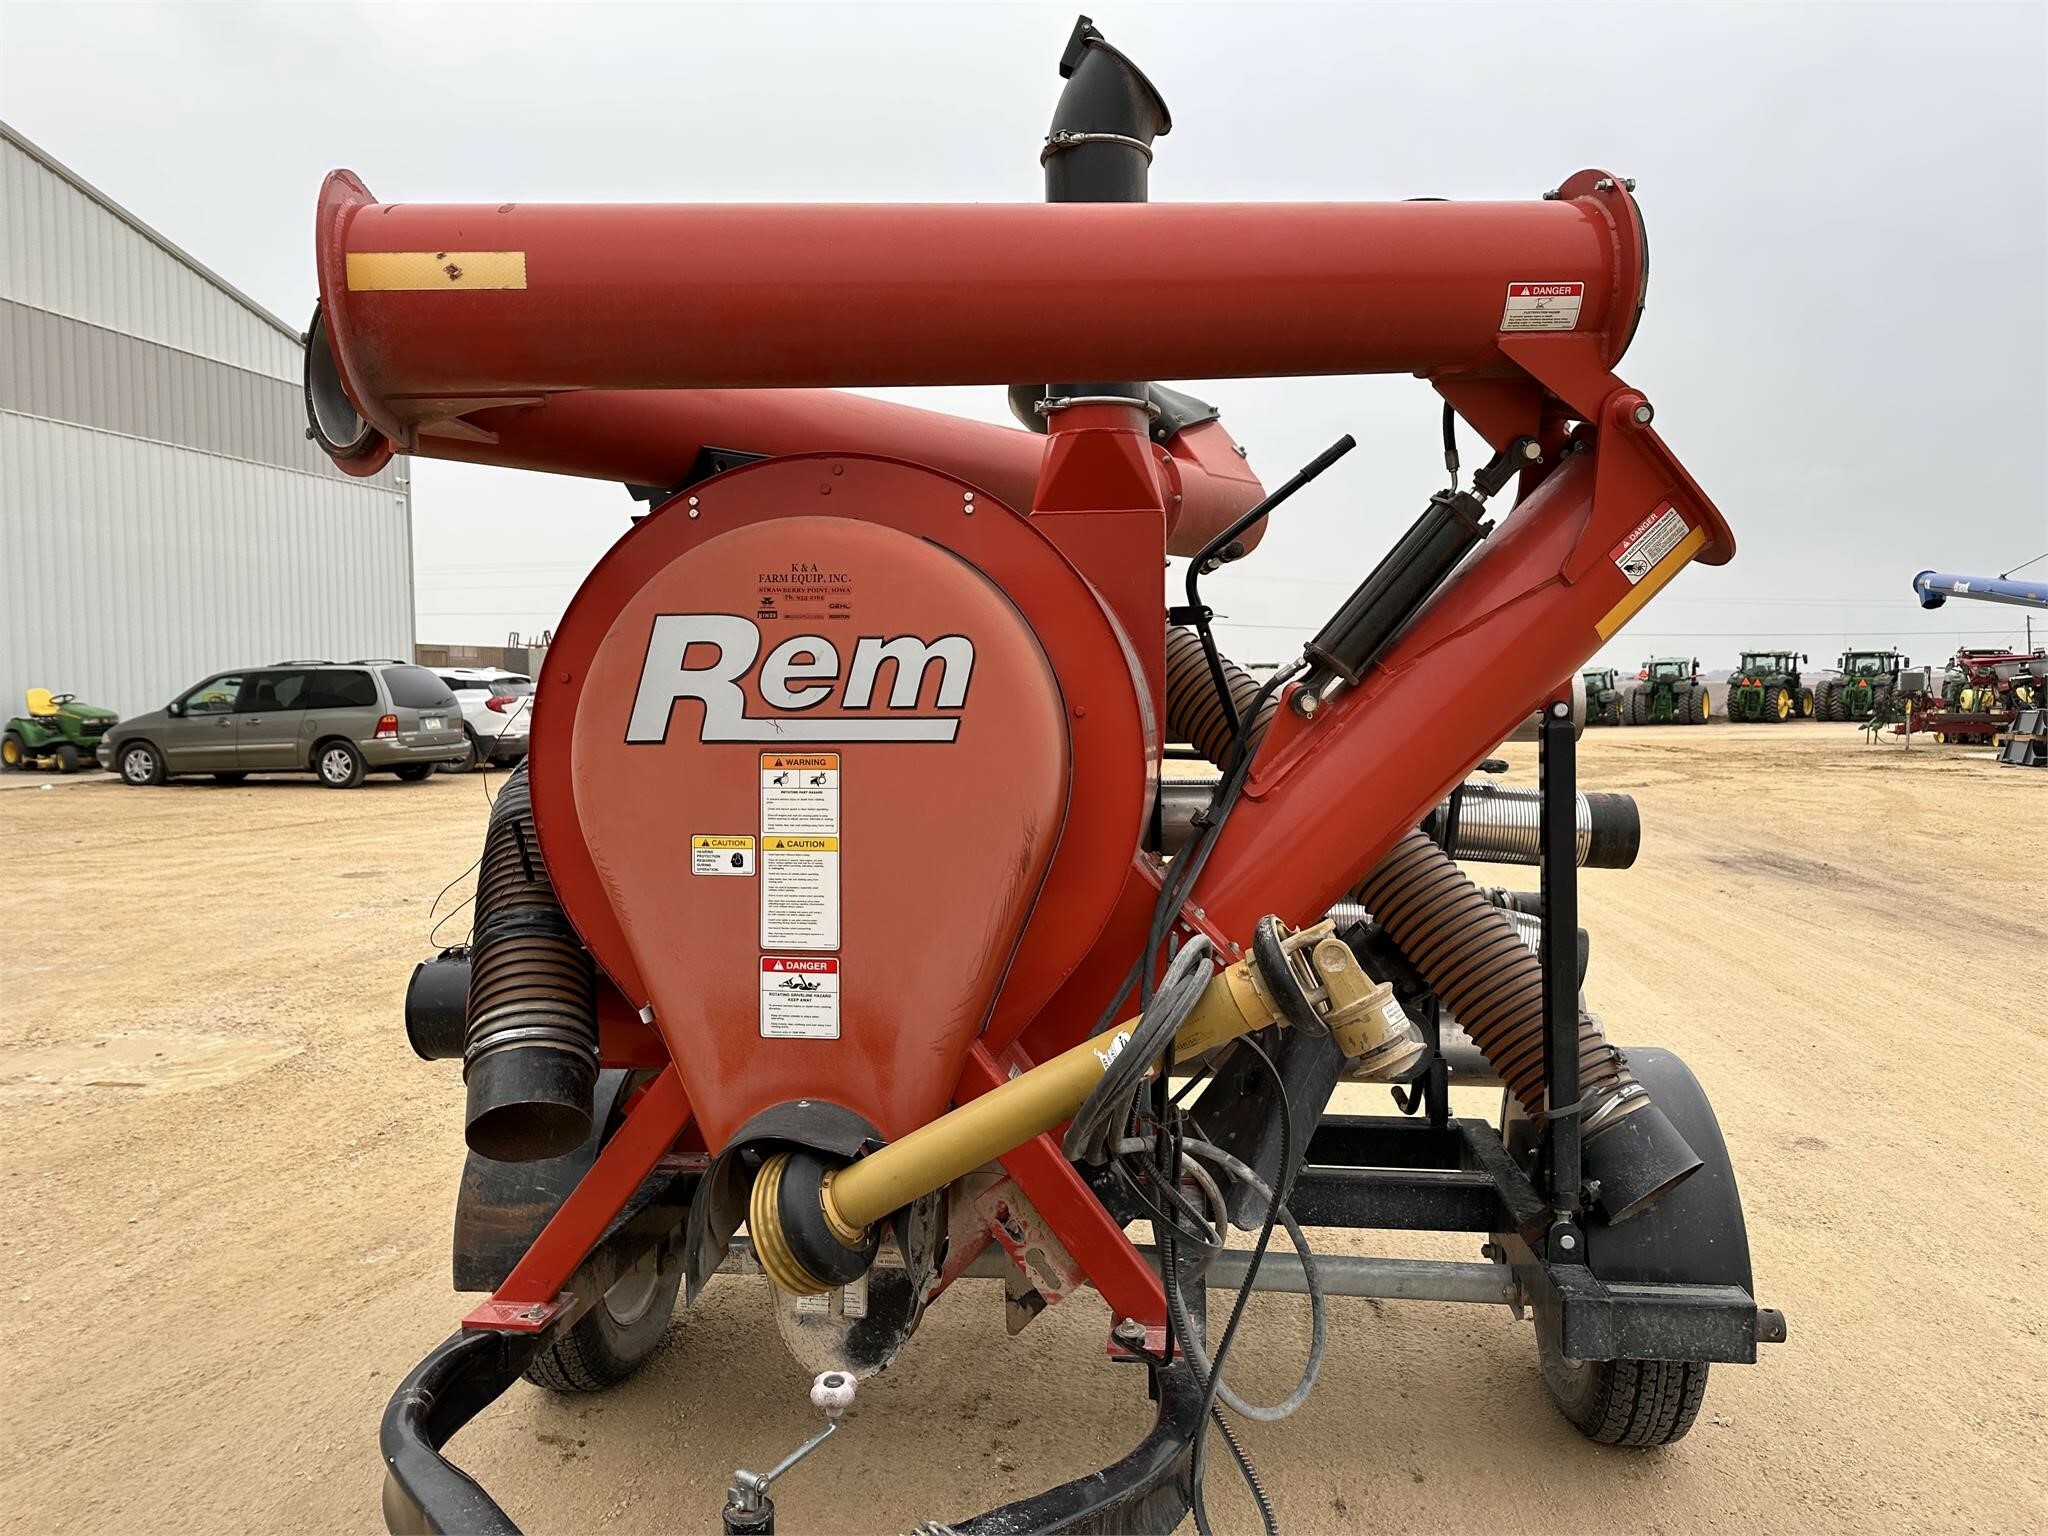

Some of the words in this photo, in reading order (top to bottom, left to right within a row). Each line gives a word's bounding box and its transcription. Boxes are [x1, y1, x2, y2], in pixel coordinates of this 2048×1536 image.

[1532, 286, 1572, 295] DANGER
[1628, 513, 1658, 541] DANGER
[791, 563, 799, 572] K
[801, 563, 808, 572] &
[811, 563, 818, 572] A
[758, 574, 788, 583] FARM
[791, 574, 826, 585] EQUIP.
[829, 573, 852, 583] INC.
[624, 613, 975, 744] Rem
[785, 758, 827, 766] WARNING
[786, 840, 825, 848] CAUTION
[785, 961, 828, 970] DANGER
